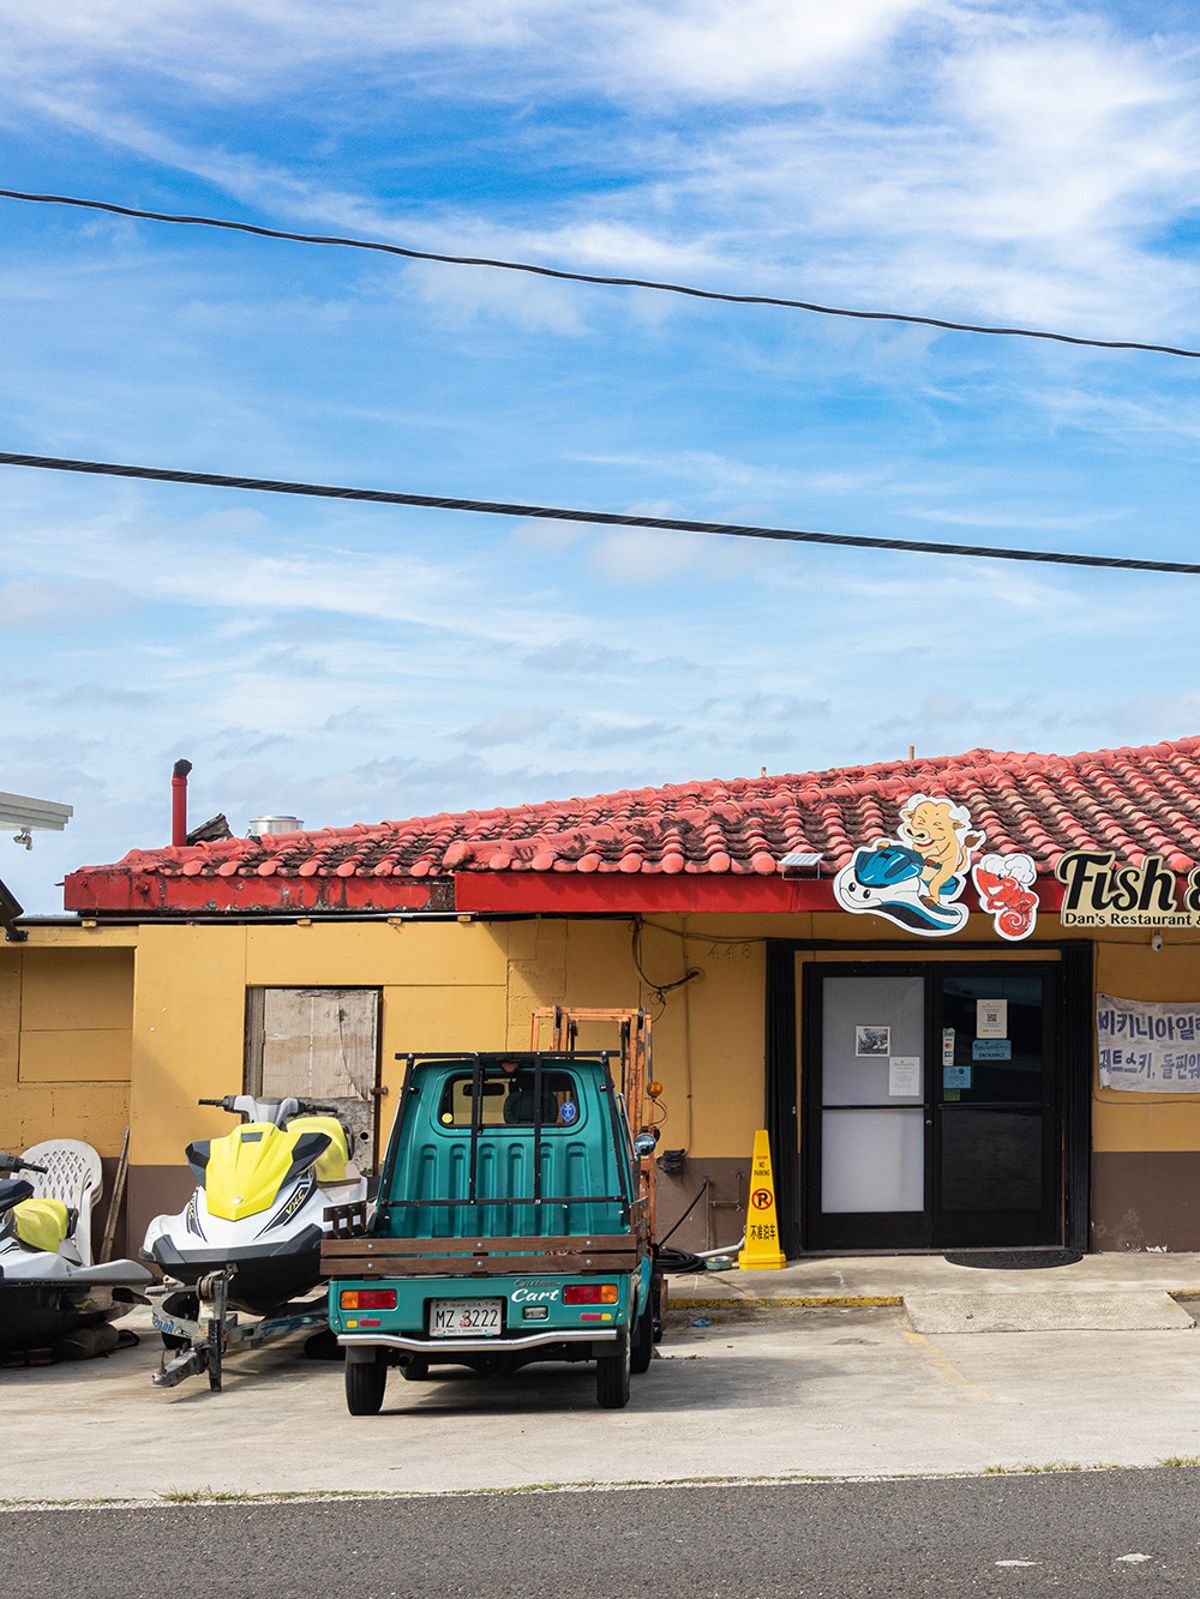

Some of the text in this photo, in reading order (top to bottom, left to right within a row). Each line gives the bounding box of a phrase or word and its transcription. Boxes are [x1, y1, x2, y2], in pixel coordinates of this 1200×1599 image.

[1059, 853, 1173, 911] Fish
[1065, 912, 1105, 925] Dan's
[1110, 913, 1191, 926] Restaurant
[511, 1288, 560, 1303] Cart
[436, 1309, 499, 1328] MZ 3222
